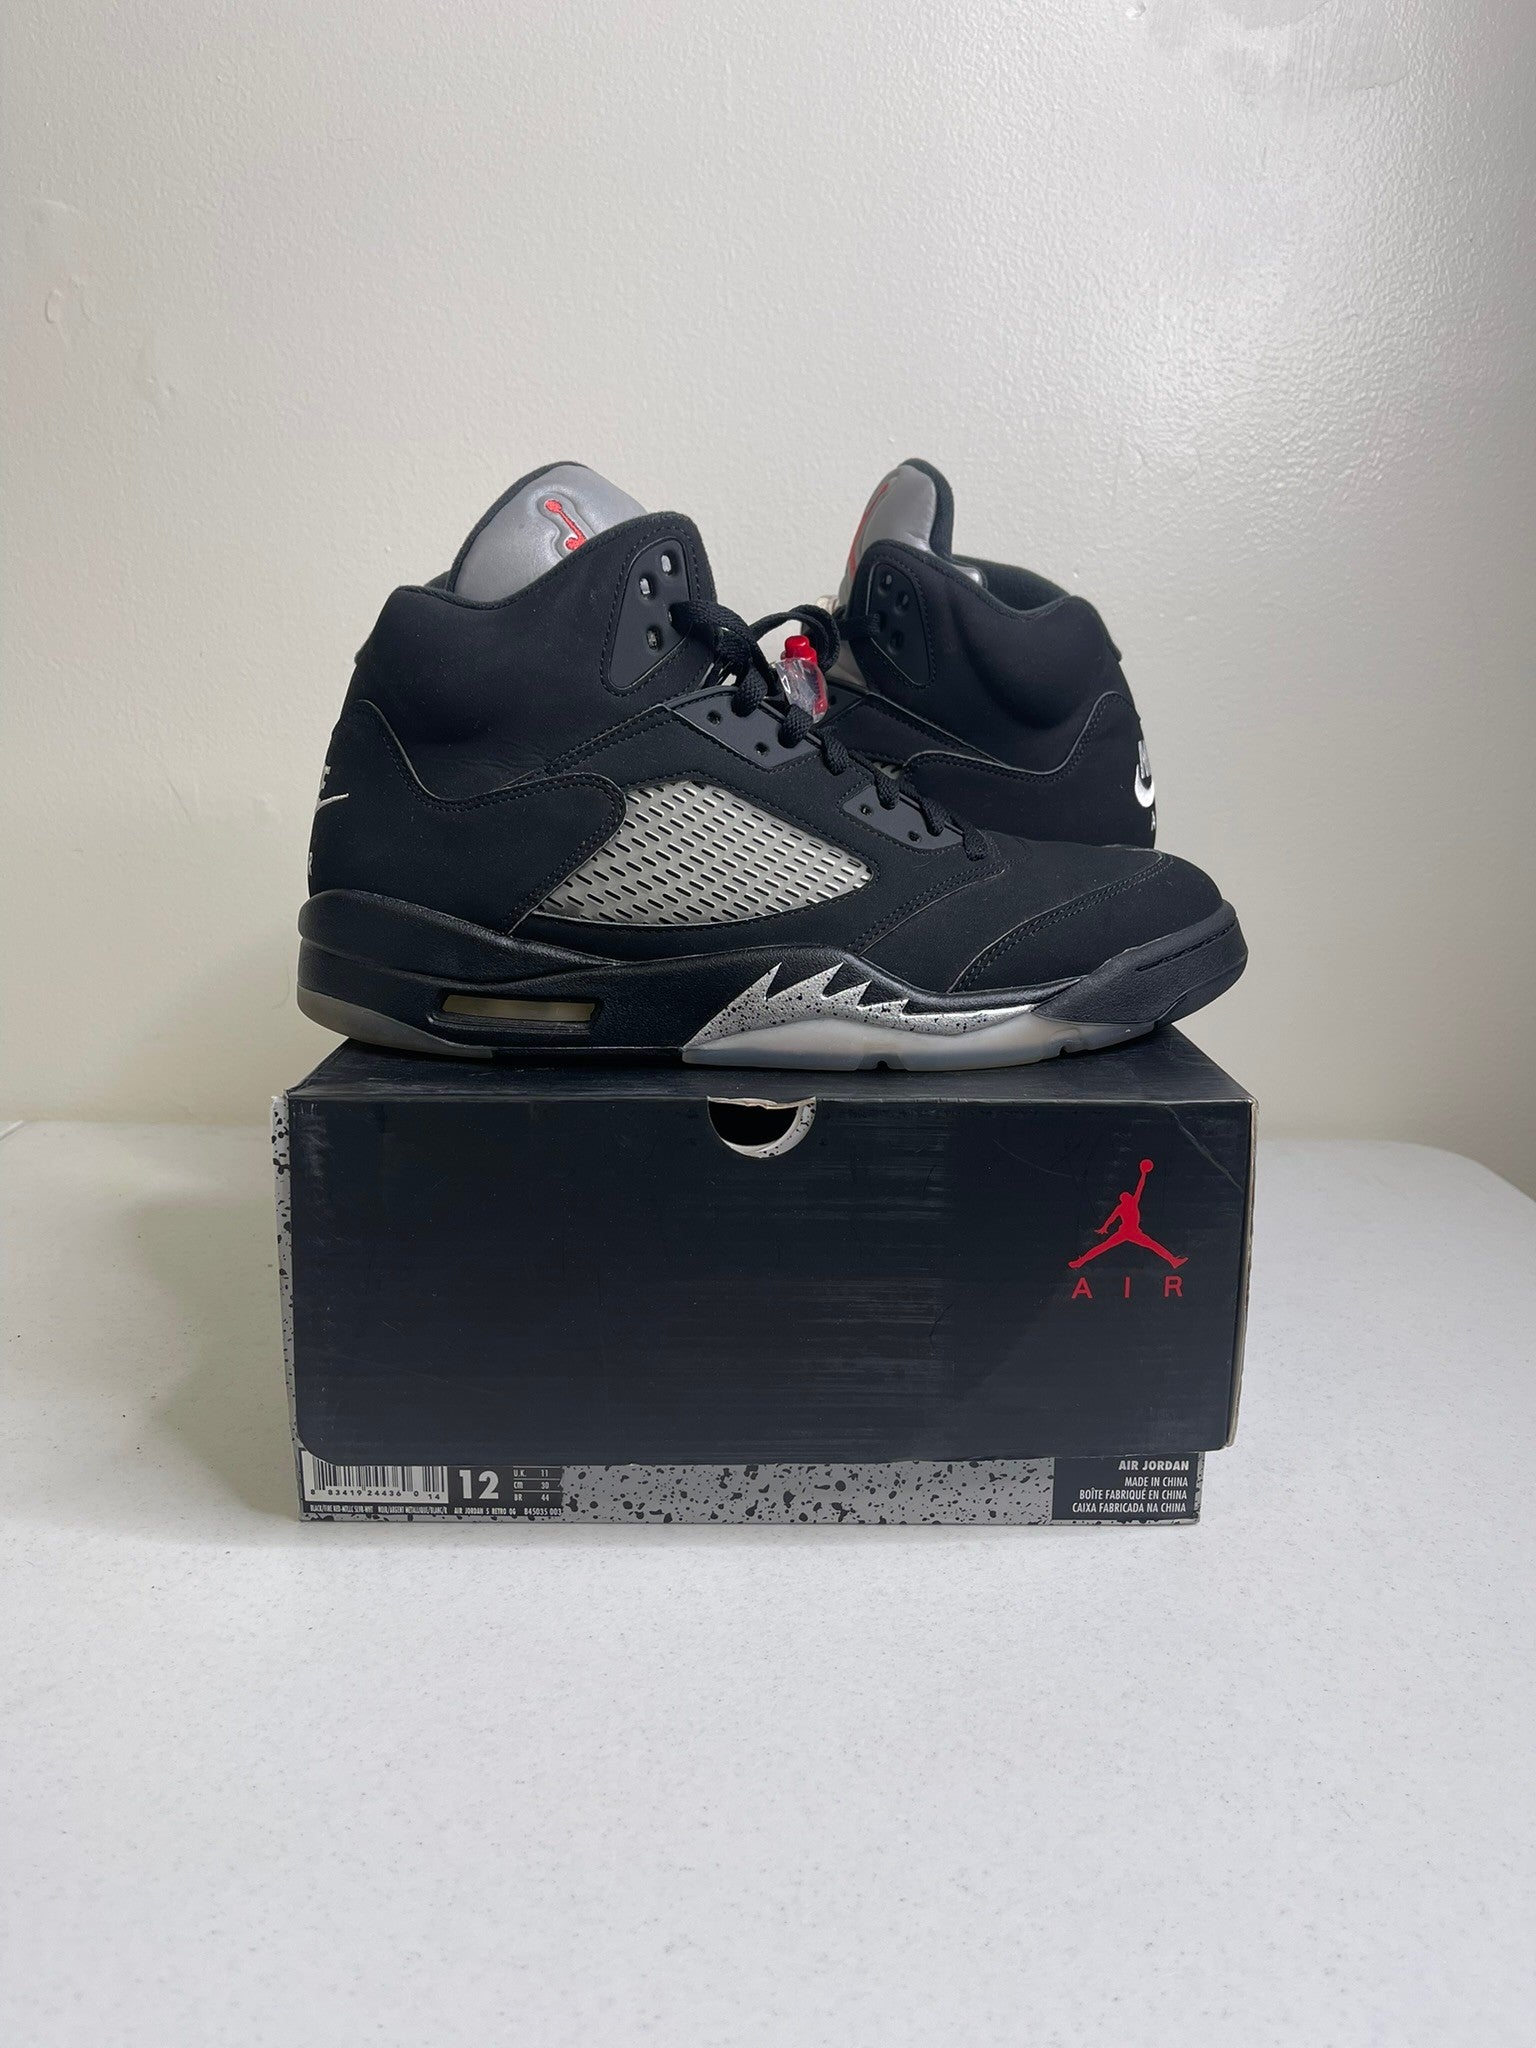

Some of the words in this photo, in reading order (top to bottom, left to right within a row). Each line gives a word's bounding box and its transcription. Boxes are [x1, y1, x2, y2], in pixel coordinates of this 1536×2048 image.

[1071, 1276, 1183, 1299] AIR
[1118, 1460, 1139, 1471] AIR
[1142, 1460, 1189, 1471] JORDAN
[541, 1469, 549, 1477] 11
[459, 1469, 499, 1499] 12
[541, 1481, 550, 1489] 30
[1124, 1477, 1149, 1487] MADE
[1151, 1477, 1160, 1487] IN
[1162, 1477, 1188, 1487] CHINA
[413, 1490, 419, 1498] 0
[1080, 1487, 1103, 1500] BOÎTE
[1105, 1487, 1146, 1501] FABRIQUÉ
[1148, 1490, 1159, 1500] EN
[1161, 1490, 1187, 1500] CHINA
[465, 1507, 484, 1515] JORDAN
[1072, 1502, 1097, 1513] CAIXA
[1099, 1502, 1144, 1513] FABRICADA
[1146, 1502, 1159, 1513] NA
[1160, 1502, 1186, 1513] CHINA
